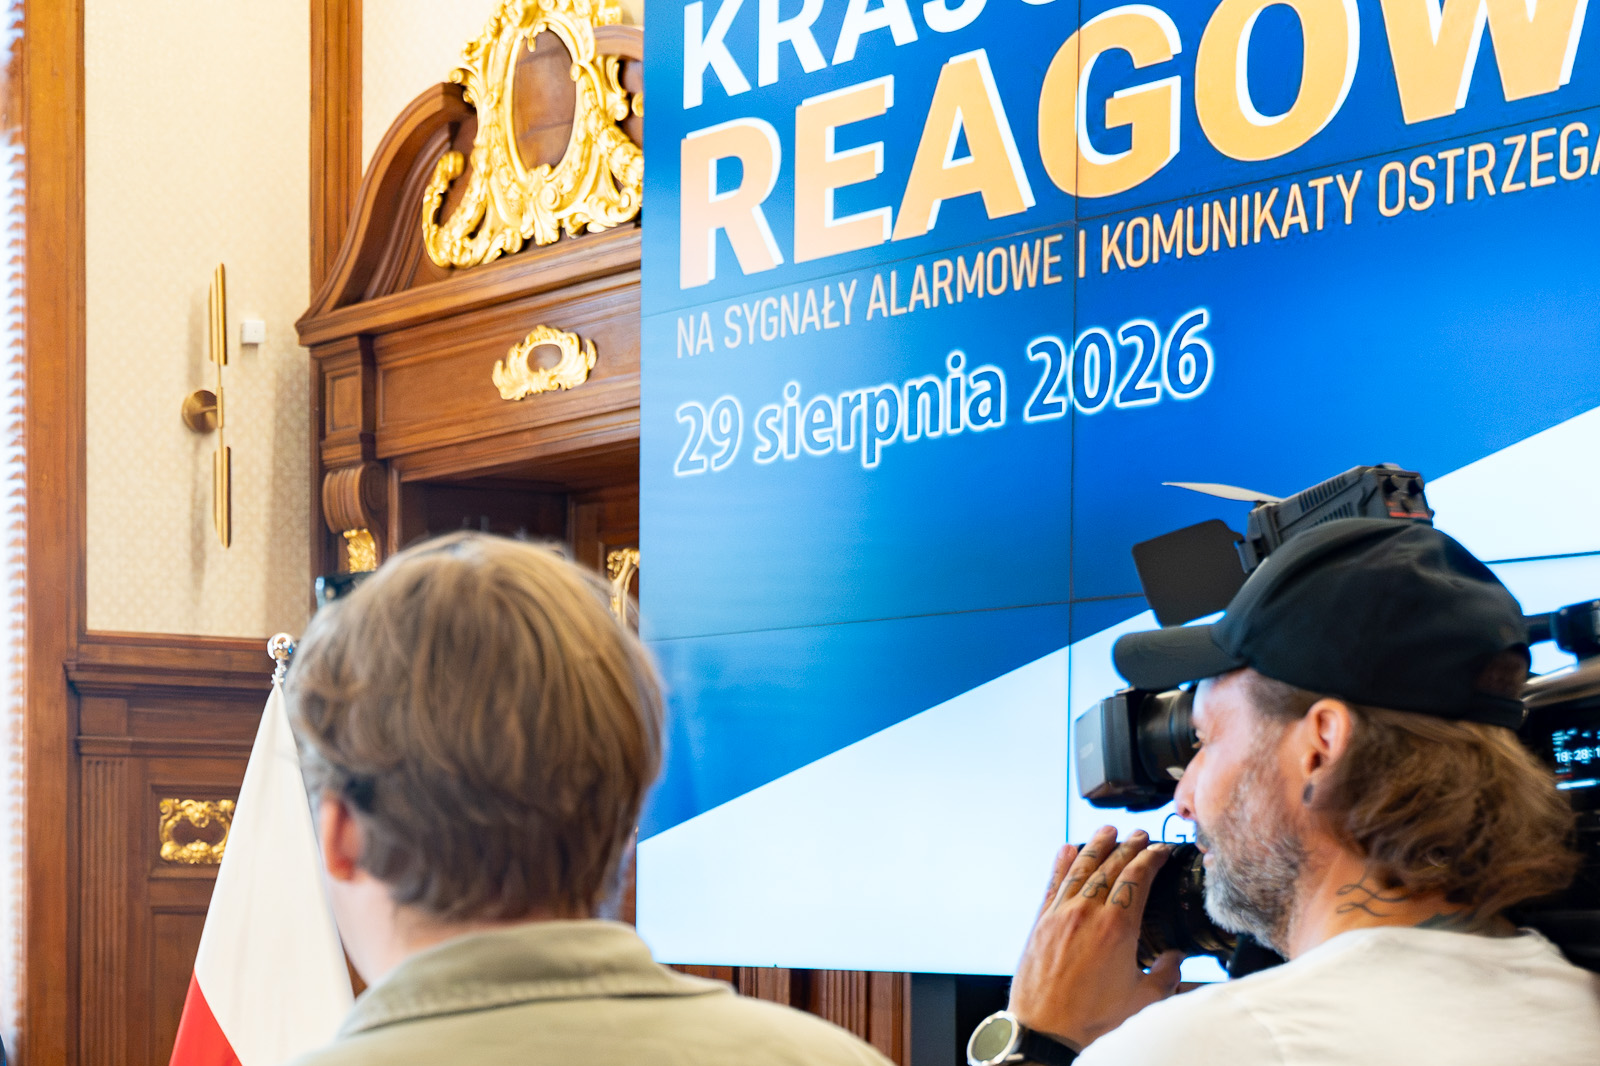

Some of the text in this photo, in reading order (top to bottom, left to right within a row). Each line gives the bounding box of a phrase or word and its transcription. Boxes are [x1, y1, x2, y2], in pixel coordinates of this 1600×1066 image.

[677, 311, 715, 359] NA
[723, 279, 858, 350] SYGNAŁY
[866, 233, 1063, 321] ALARMOWE
[1078, 229, 1086, 279] I
[1101, 170, 1363, 274] KOMUNIKATY
[673, 307, 1214, 477] 29 sierpnia 2026
